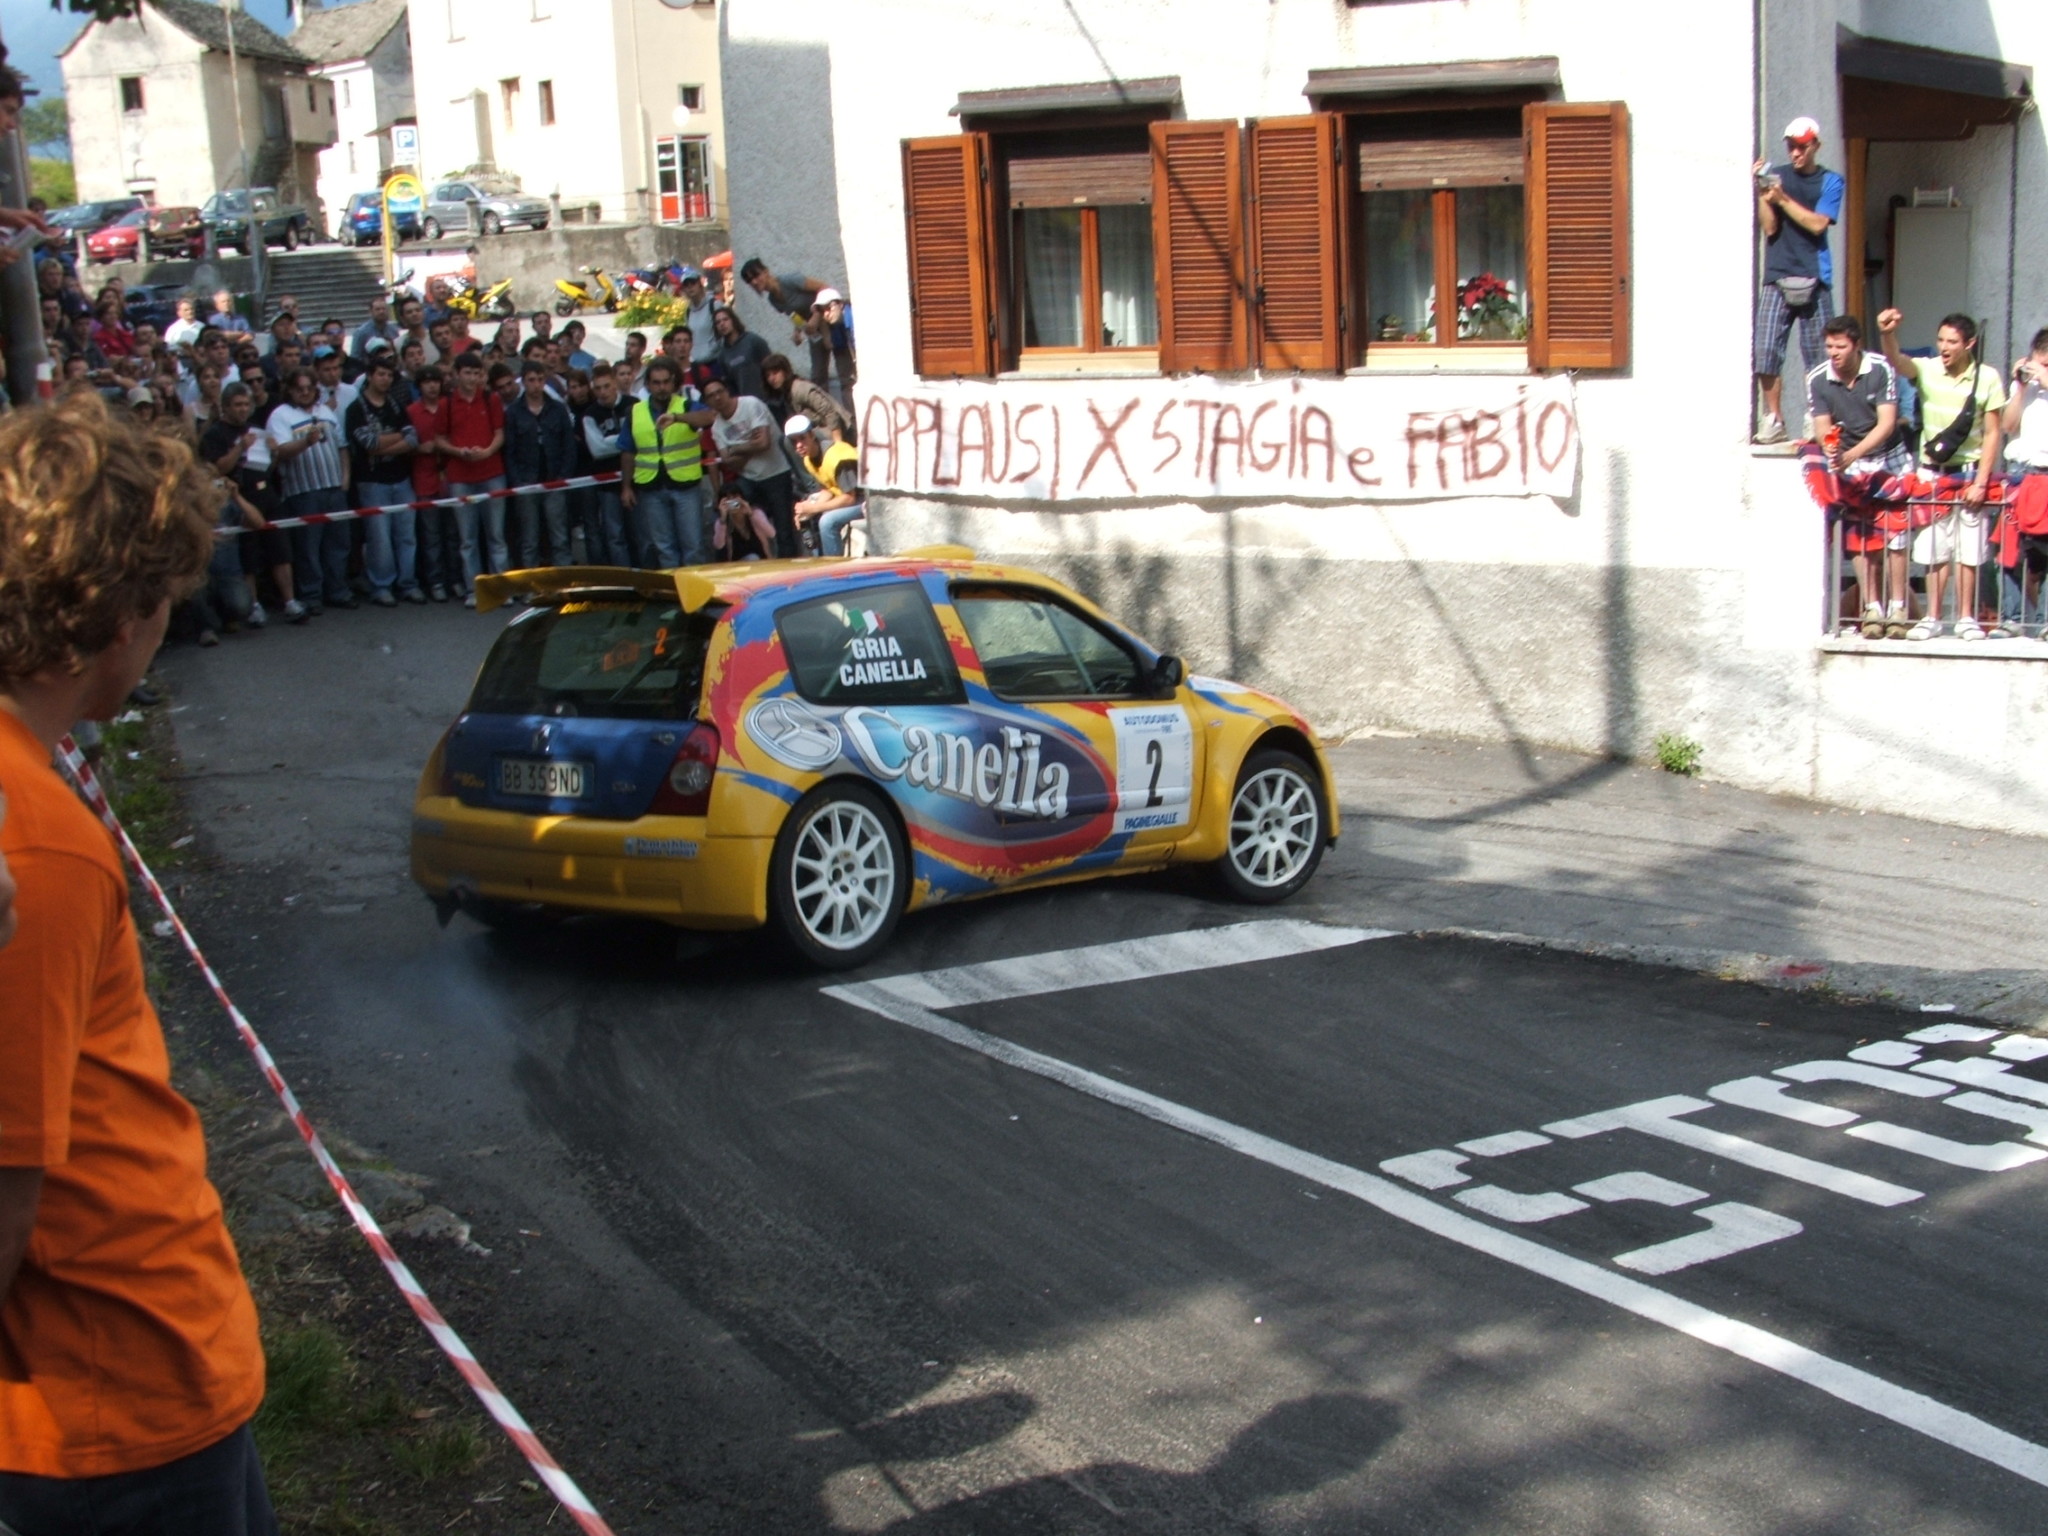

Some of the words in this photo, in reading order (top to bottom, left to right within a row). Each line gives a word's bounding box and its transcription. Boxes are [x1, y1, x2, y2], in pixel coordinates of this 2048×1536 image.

[861, 394, 1060, 500] APPLAUSI
[1077, 396, 1141, 494] X
[1348, 447, 1382, 486] e
[654, 627, 668, 655] 2
[851, 636, 902, 660] GRIA
[840, 658, 927, 687] CANELLA
[1145, 739, 1163, 808] 2
